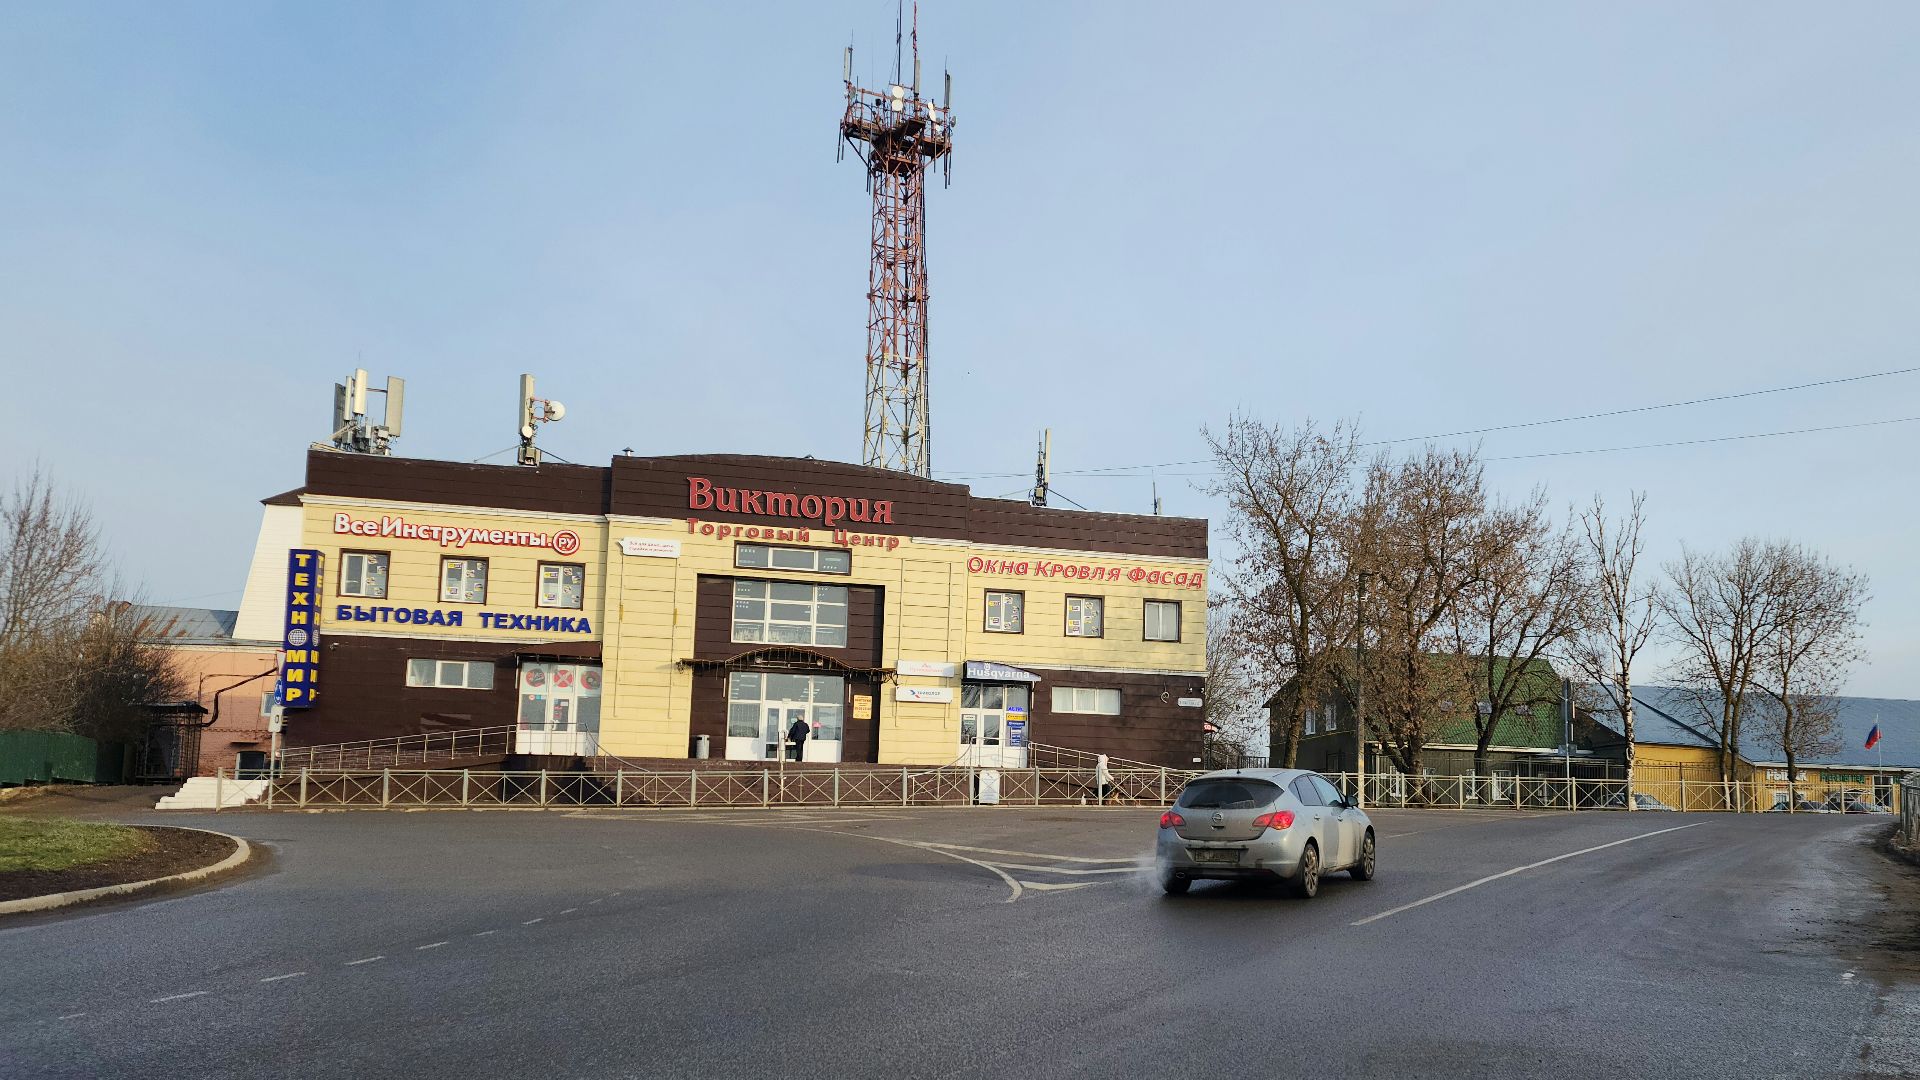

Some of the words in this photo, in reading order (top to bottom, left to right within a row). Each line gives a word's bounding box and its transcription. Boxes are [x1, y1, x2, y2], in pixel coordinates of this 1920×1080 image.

[687, 477, 895, 527] Виктория
[686, 517, 810, 543] Торговый
[833, 528, 900, 551] Центр
[336, 604, 463, 627] БЫТОВАЯ
[479, 611, 592, 634] ТЕХНИКА
[967, 667, 1030, 680] Husqvarna
